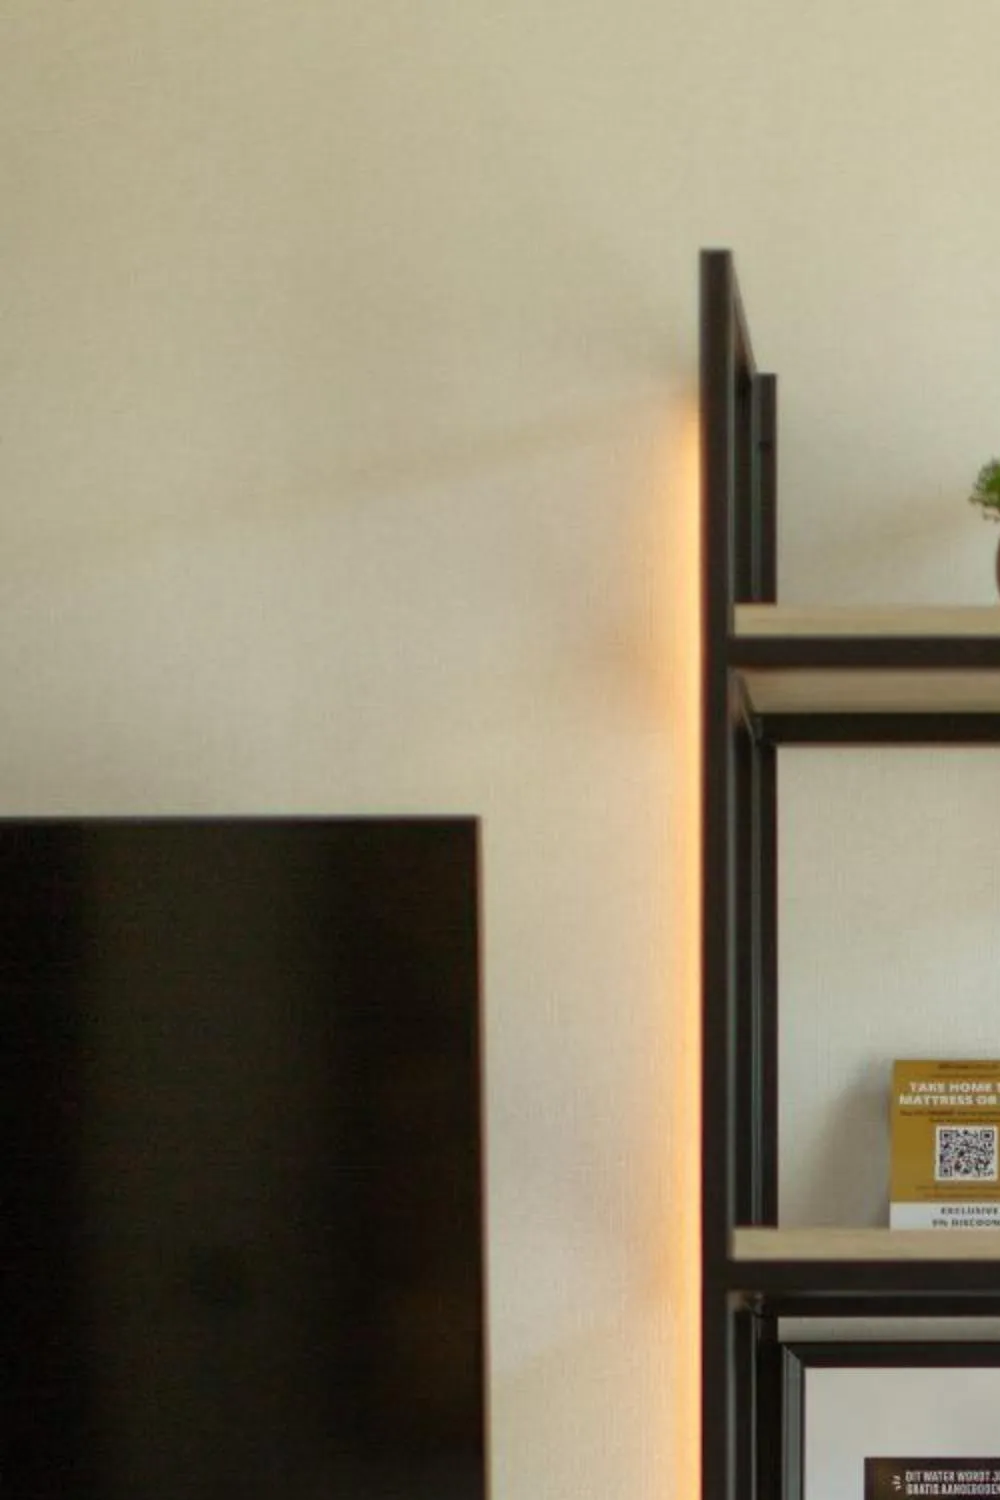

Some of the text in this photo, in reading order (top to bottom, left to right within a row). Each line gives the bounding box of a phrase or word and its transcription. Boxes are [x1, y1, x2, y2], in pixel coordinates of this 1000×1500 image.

[910, 1081, 945, 1093] TAKE
[949, 1081, 992, 1093] HOME
[900, 1094, 973, 1106] MATTRESS
[975, 1094, 997, 1106] OR
[923, 1470, 955, 1483] WATER
